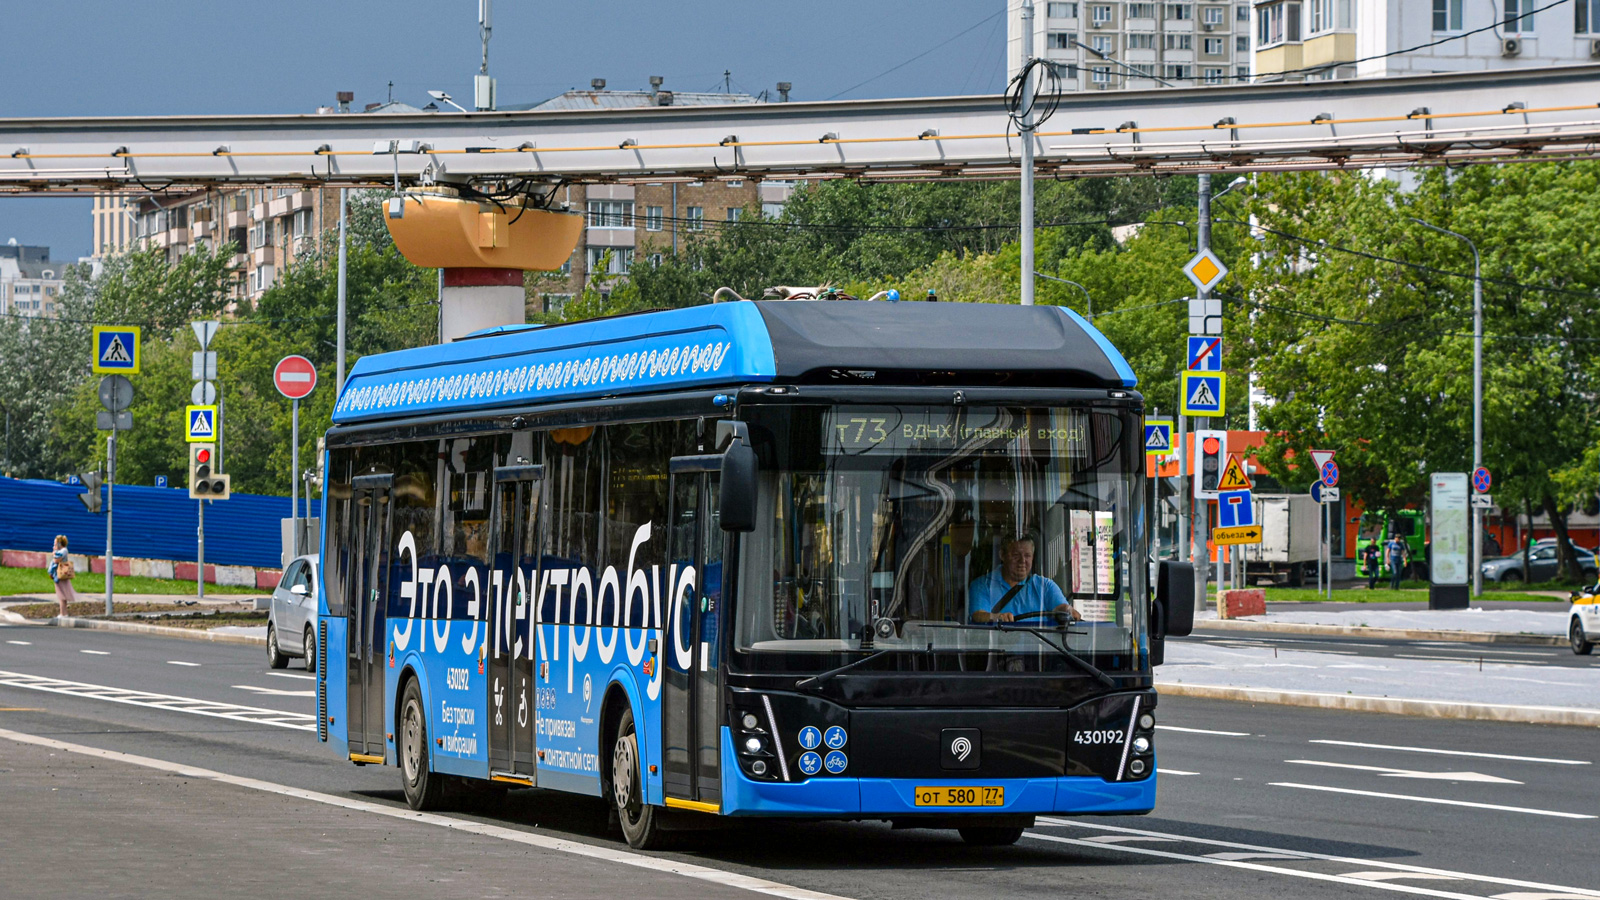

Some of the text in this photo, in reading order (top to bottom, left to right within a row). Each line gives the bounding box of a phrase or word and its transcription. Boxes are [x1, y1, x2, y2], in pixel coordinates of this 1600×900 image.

[903, 423, 952, 440] ВДНХ
[960, 423, 1030, 440] (главный
[1037, 425, 1085, 442] вход)
[158, 476, 165, 486] P
[1216, 532, 1245, 540] объезд
[393, 530, 453, 653] Это
[446, 667, 470, 690] 430192
[441, 700, 475, 729] Без тряски
[535, 711, 576, 741] Не привязан
[442, 730, 477, 759] и вибраций
[1074, 730, 1124, 744] 430192
[544, 746, 583, 770] контактной
[583, 752, 599, 772] сети
[922, 788, 999, 803] ОТ 580 77
